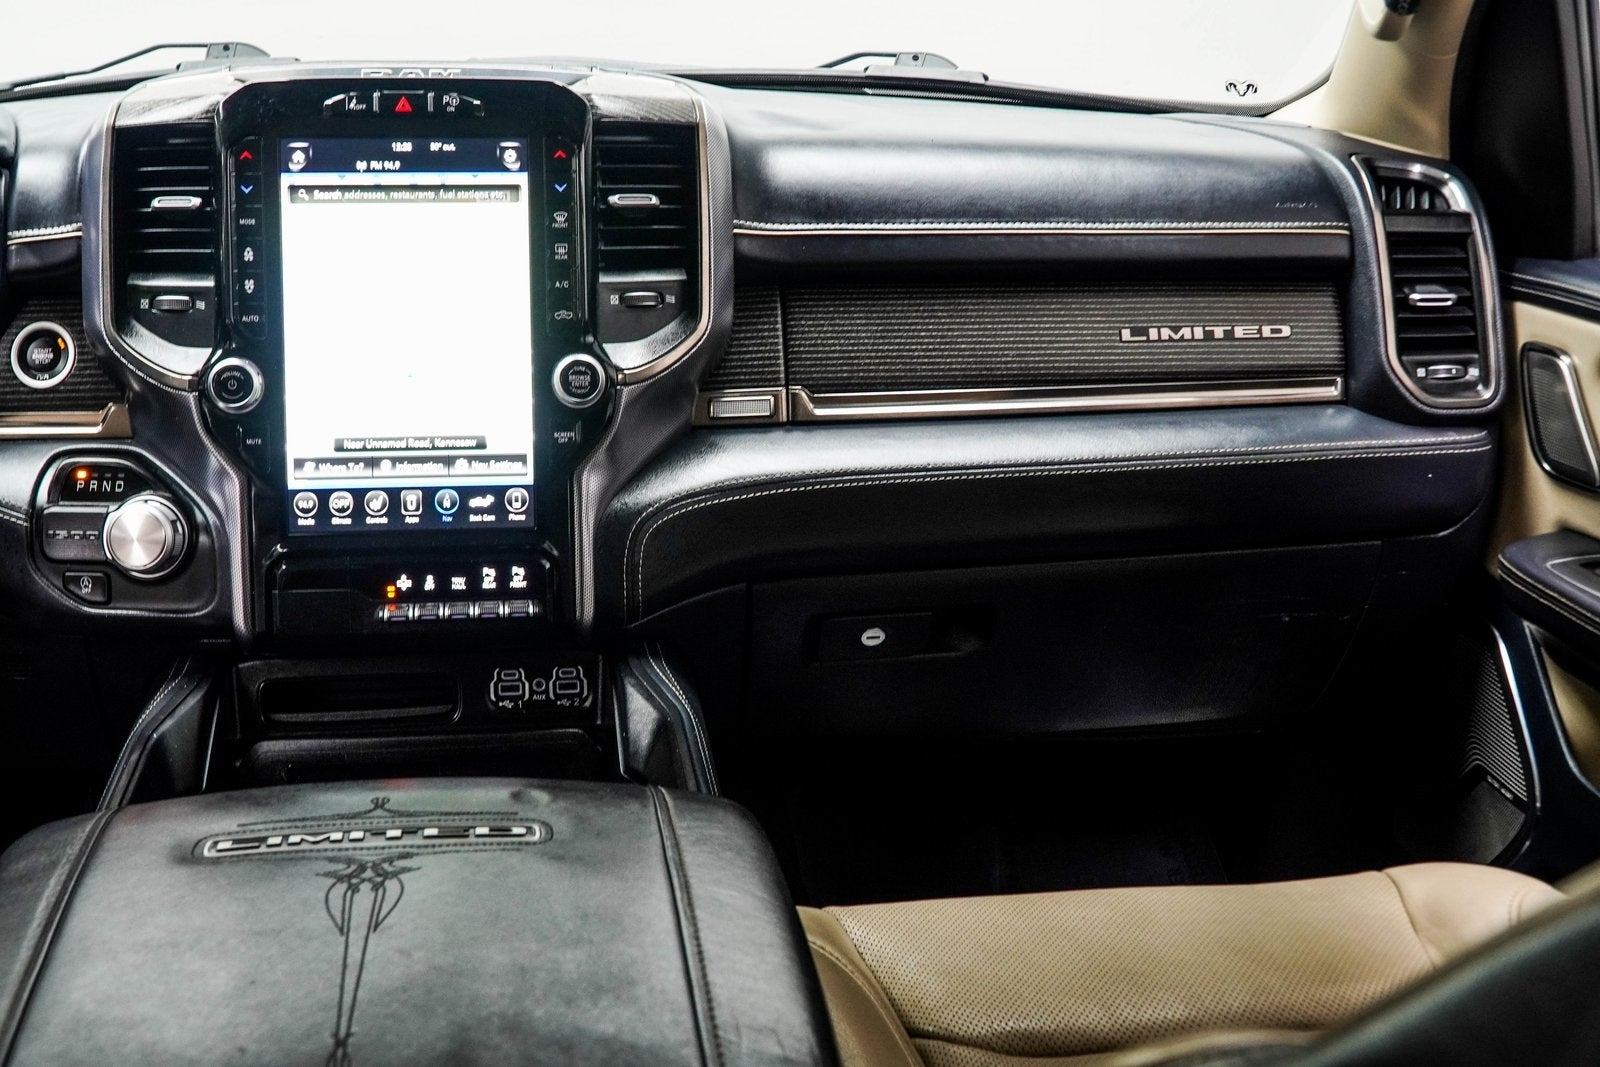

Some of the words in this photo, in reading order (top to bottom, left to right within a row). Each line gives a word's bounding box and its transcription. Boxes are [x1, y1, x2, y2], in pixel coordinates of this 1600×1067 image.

[369, 160, 383, 170] FM
[313, 188, 342, 201] Search
[344, 188, 388, 200] addresses,
[389, 188, 437, 200] restaurants,
[439, 188, 456, 200] fuel
[555, 280, 569, 289] A/C
[241, 314, 259, 323] AUTO
[1119, 324, 1293, 343] LIMITED
[246, 438, 262, 446] MUTE
[343, 438, 364, 450] Near
[365, 437, 407, 449] Unnamed
[408, 437, 433, 449] Road,
[434, 436, 477, 448] Kennesaw
[318, 462, 347, 473] Where
[395, 460, 444, 473] Information
[332, 498, 351, 510] OFF
[532, 693, 546, 702] AUX
